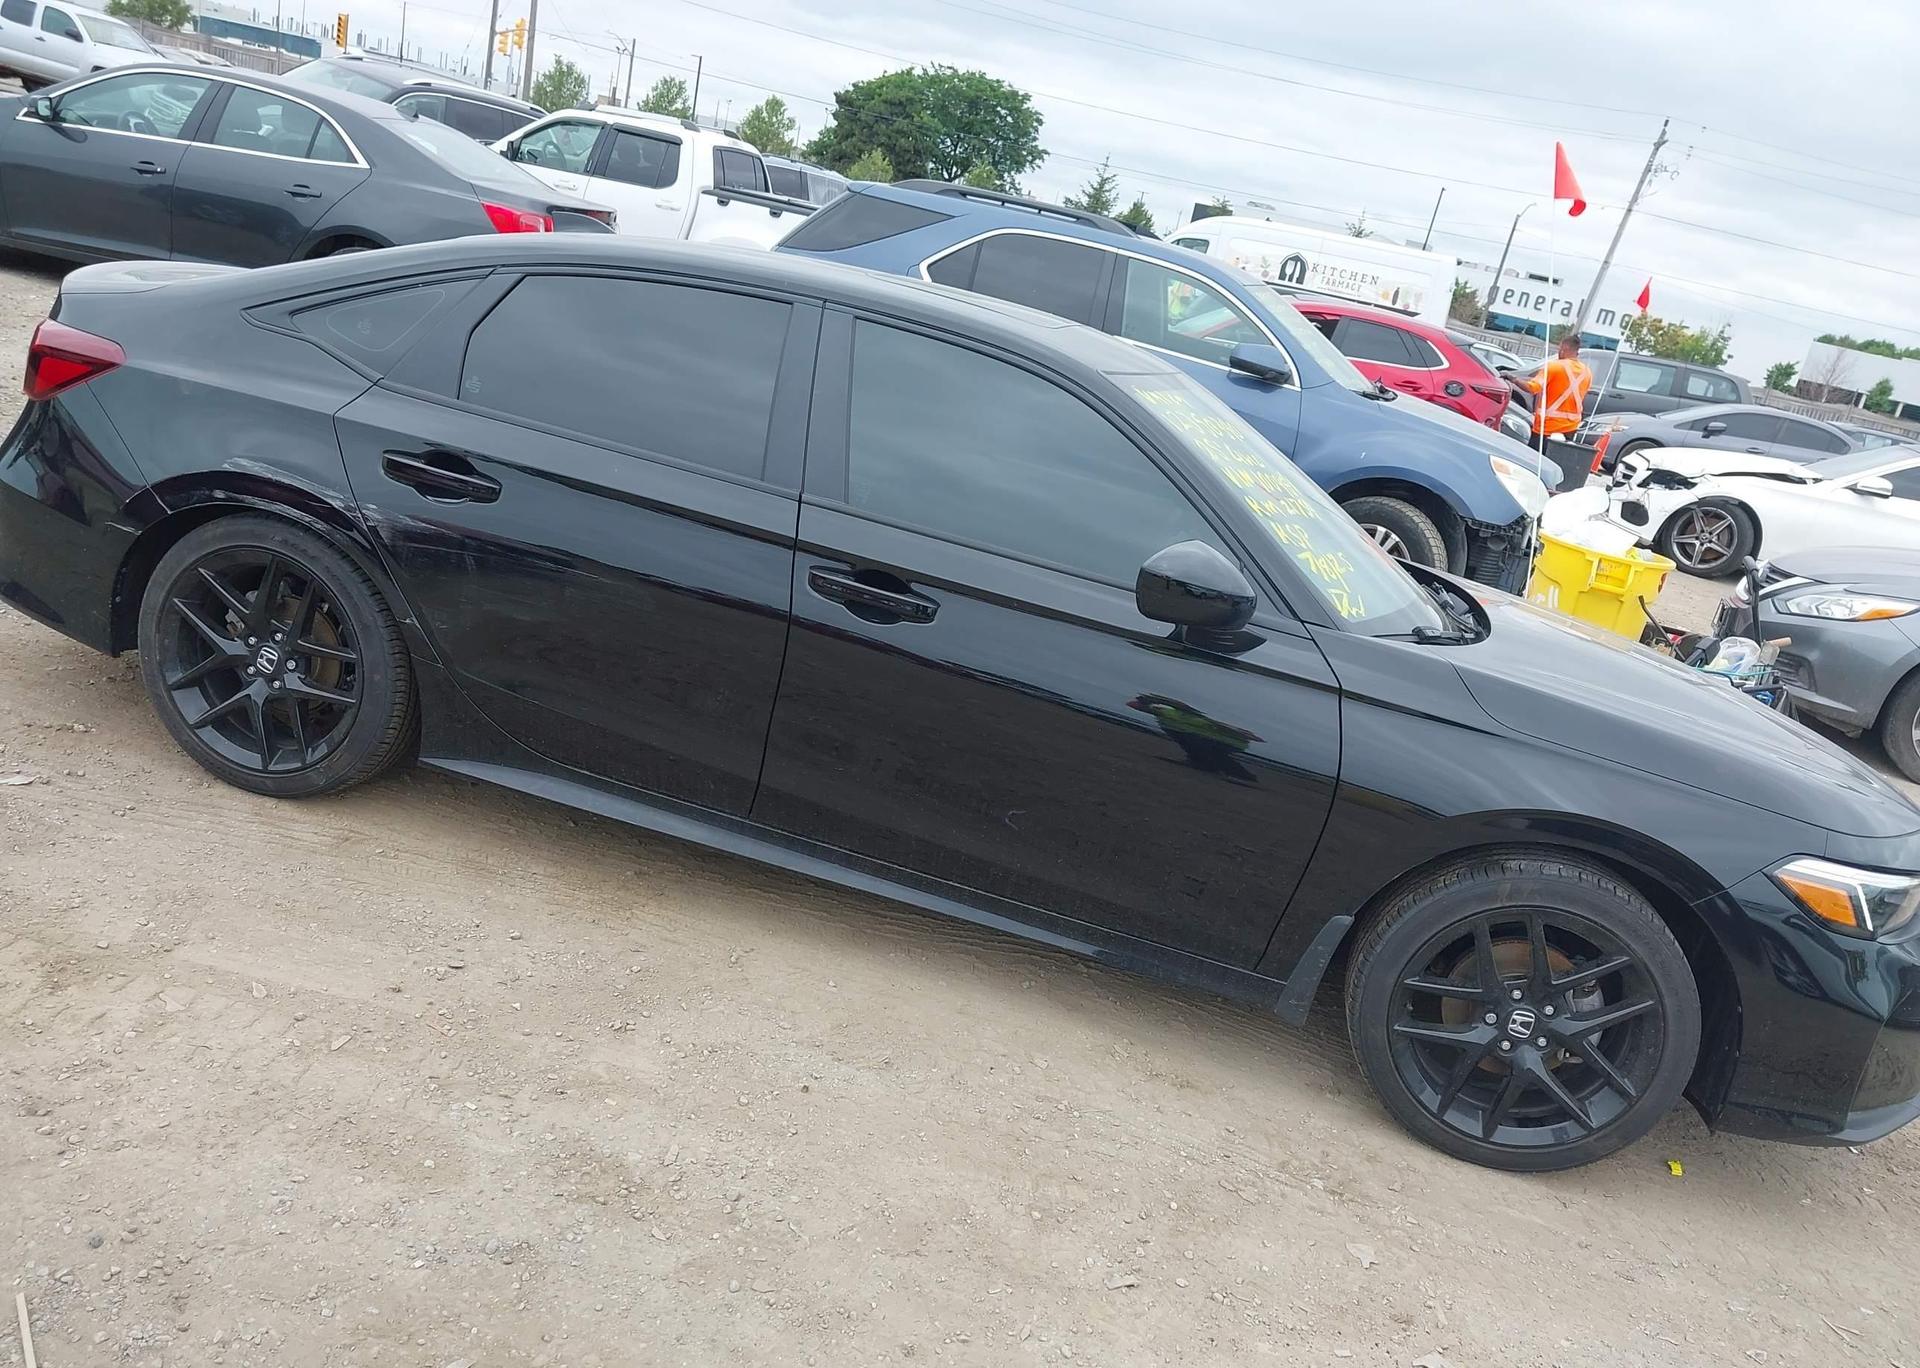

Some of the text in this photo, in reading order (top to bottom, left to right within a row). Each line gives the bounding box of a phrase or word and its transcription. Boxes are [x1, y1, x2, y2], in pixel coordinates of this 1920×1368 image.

[1311, 263, 1379, 285] KITCHEN
[1320, 275, 1362, 292] FARMACY
[1487, 285, 1586, 318] general
